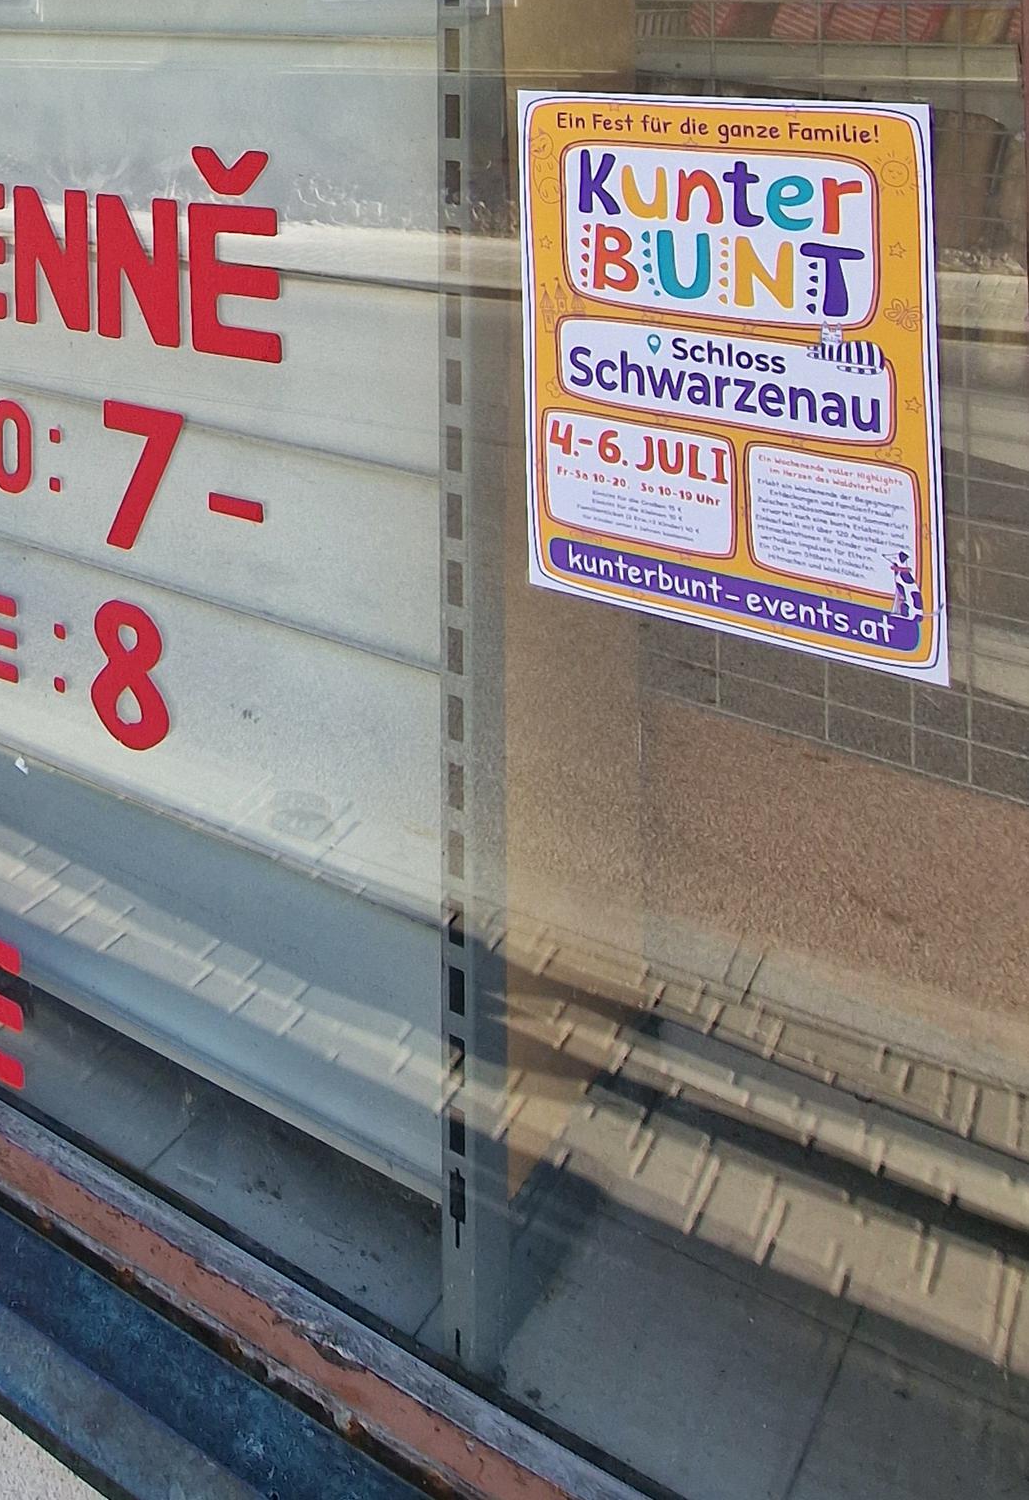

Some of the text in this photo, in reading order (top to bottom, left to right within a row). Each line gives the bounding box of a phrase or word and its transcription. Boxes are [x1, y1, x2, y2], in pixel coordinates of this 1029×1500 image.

[557, 113, 879, 143] Ein Fest für die ganze Familie!
[578, 149, 863, 235] Kunter
[593, 223, 865, 317] BUNT
[569, 346, 881, 433] Schwarzenau
[672, 337, 786, 374] Schloss
[636, 436, 728, 485] JULI
[641, 482, 654, 493] So
[659, 486, 692, 501] 10-19
[697, 494, 720, 506] Uhr
[567, 544, 895, 643] kunterbunt-events.at
[91, 600, 170, 751] 8
